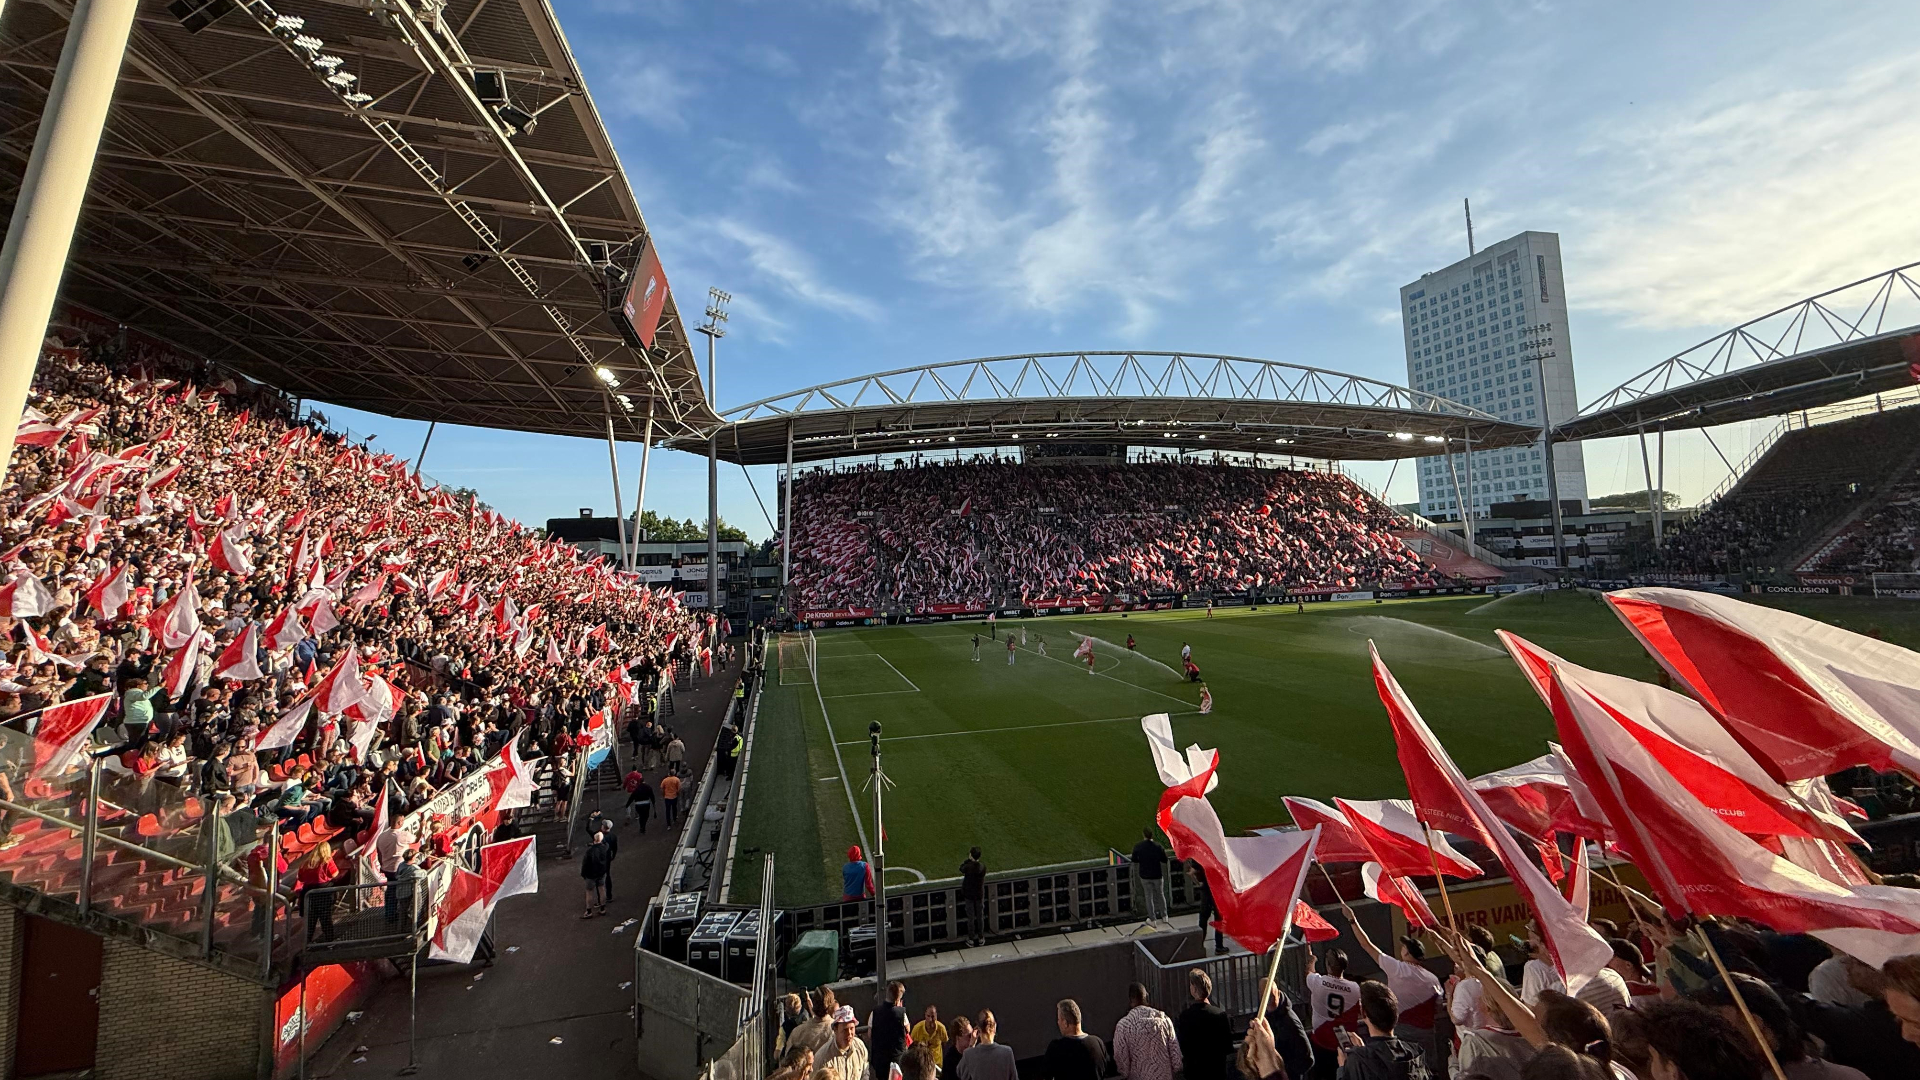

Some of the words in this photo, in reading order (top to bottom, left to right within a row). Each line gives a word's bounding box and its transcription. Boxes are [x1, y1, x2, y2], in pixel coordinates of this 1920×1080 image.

[1767, 586, 1829, 594] CONCLUSION
[685, 595, 703, 603] UTB
[1278, 595, 1322, 603] CASORE
[1718, 808, 1746, 817] CLUB!
[1322, 980, 1352, 993] DOUVIKAS
[1327, 993, 1345, 1019] 9
